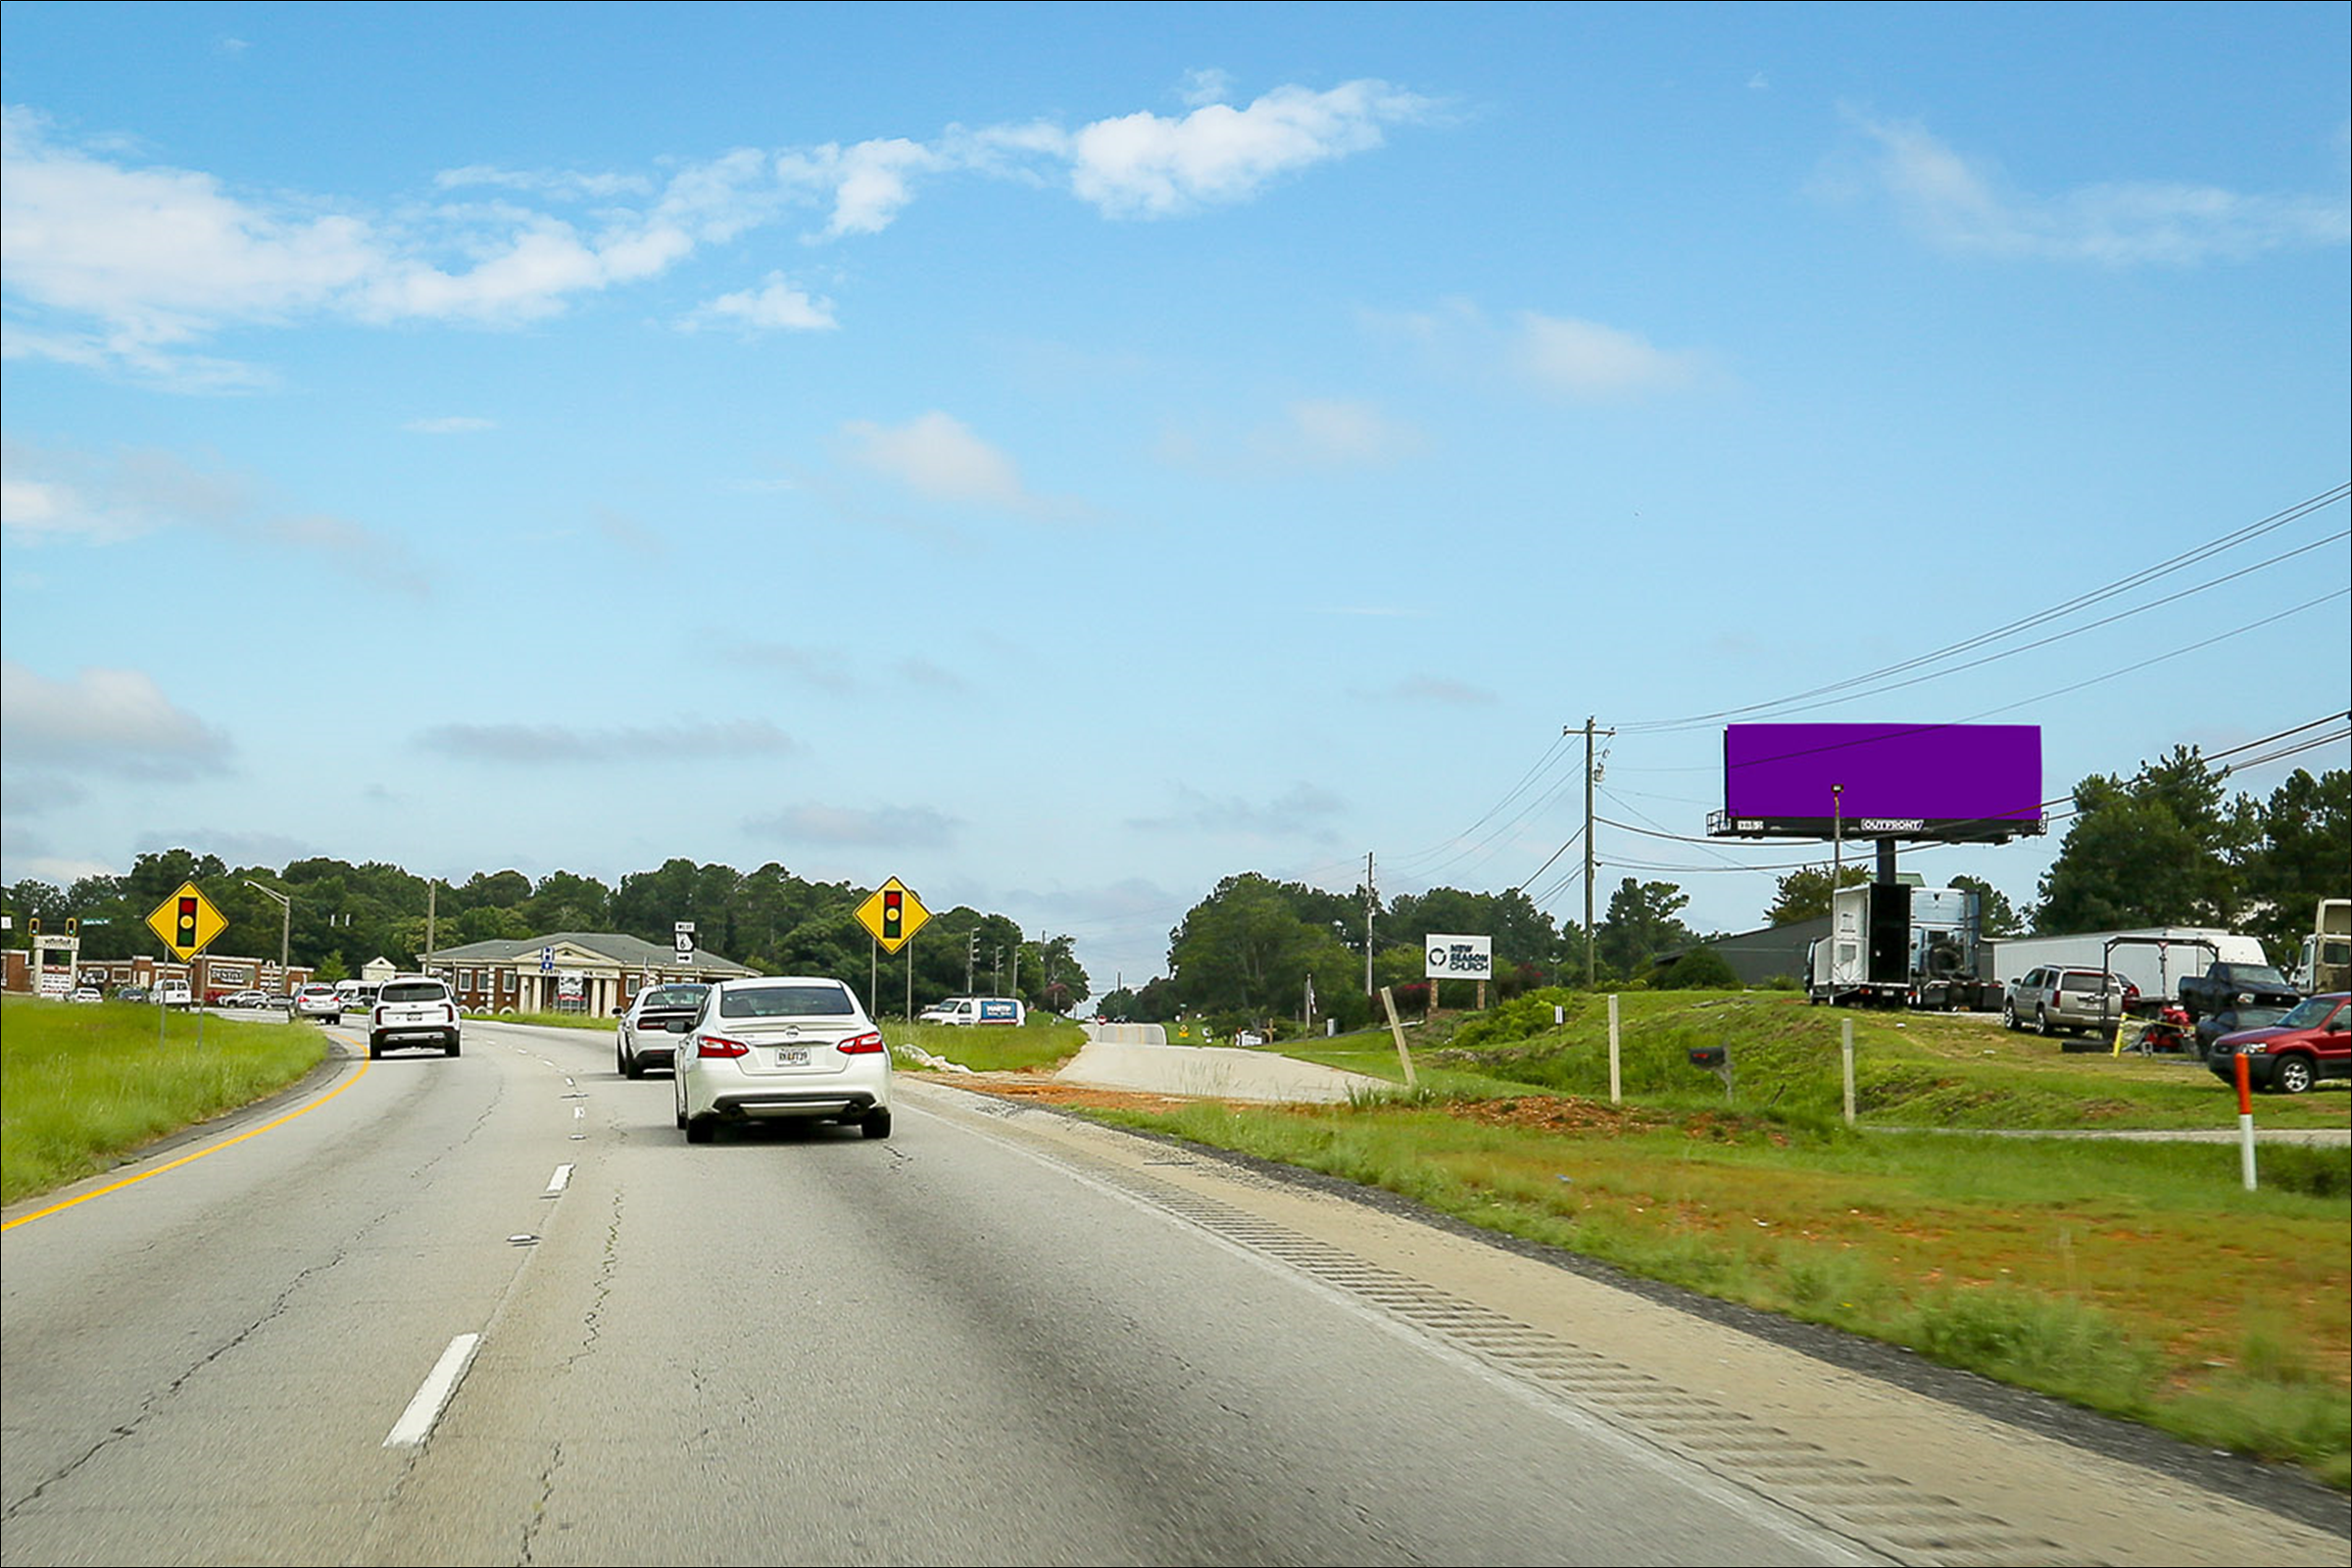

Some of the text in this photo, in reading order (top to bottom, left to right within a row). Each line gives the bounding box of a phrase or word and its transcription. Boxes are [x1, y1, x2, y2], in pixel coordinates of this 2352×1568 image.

[1864, 820, 1918, 831] OUTFRONT
[679, 938, 686, 950] 6
[1450, 953, 1488, 962] SEASON
[1449, 961, 1489, 971] CHURCH
